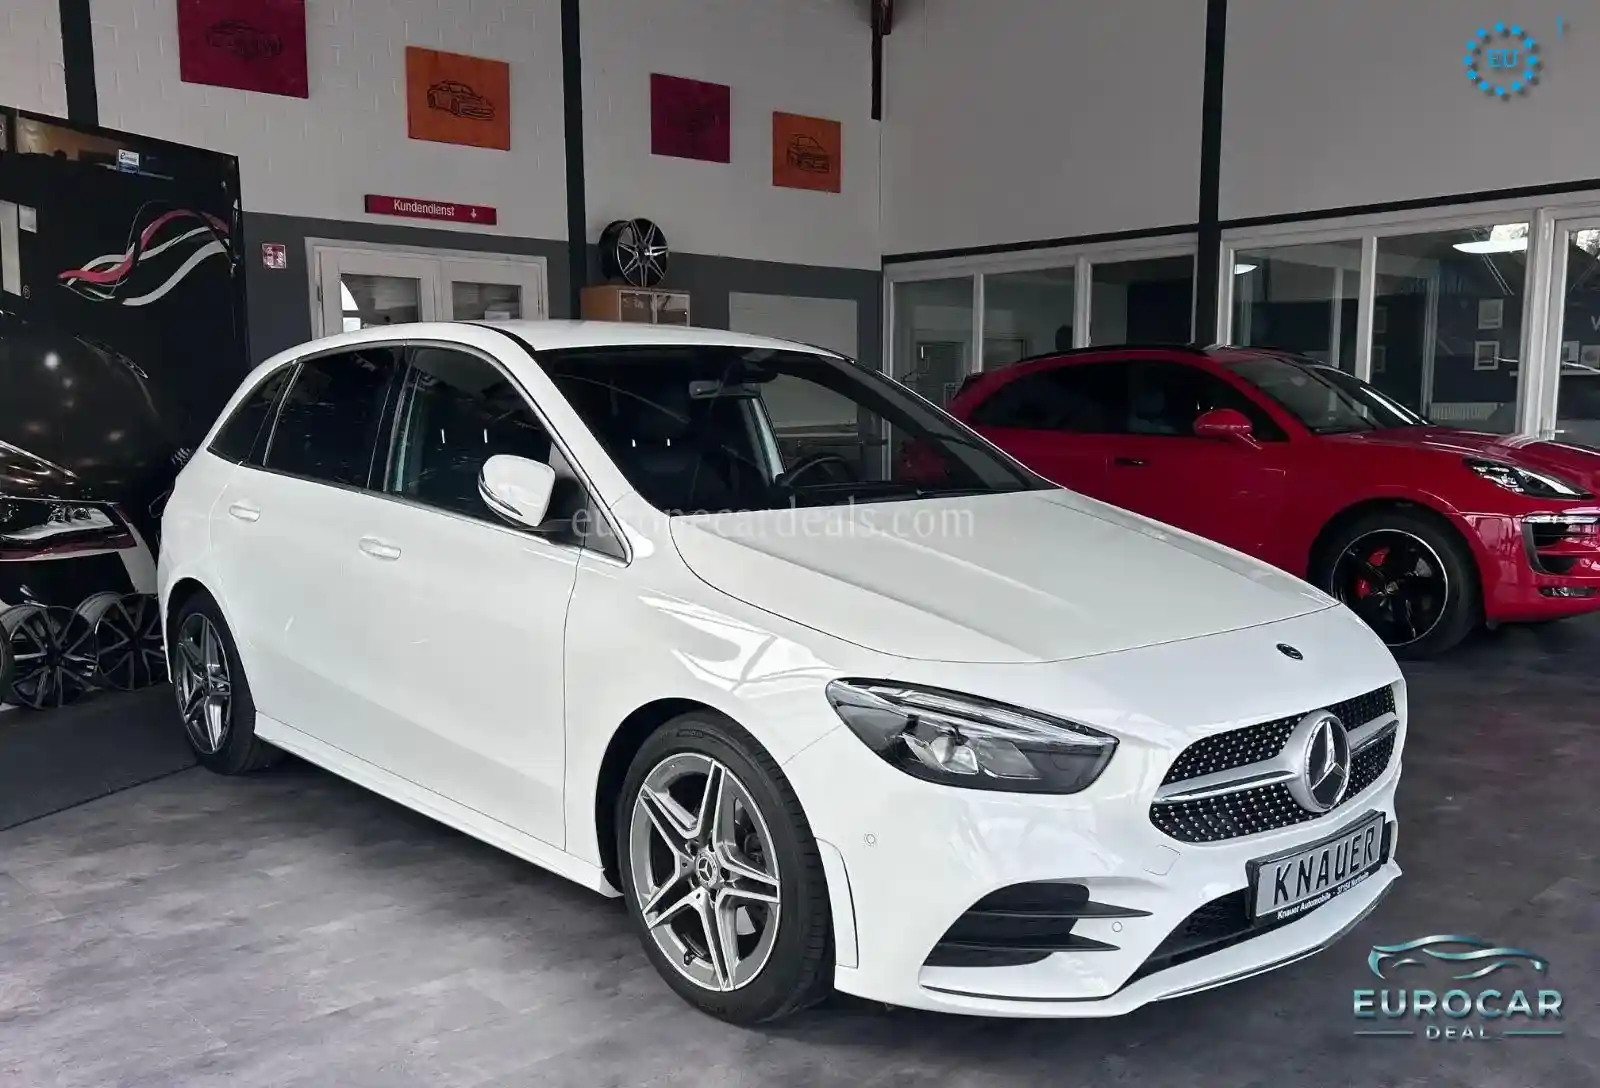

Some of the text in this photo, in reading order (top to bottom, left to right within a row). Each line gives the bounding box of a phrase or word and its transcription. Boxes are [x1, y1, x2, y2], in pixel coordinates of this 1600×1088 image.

[393, 199, 455, 216] Kundendienst
[1273, 825, 1375, 906] KNAUER
[1277, 904, 1300, 920] Knauer
